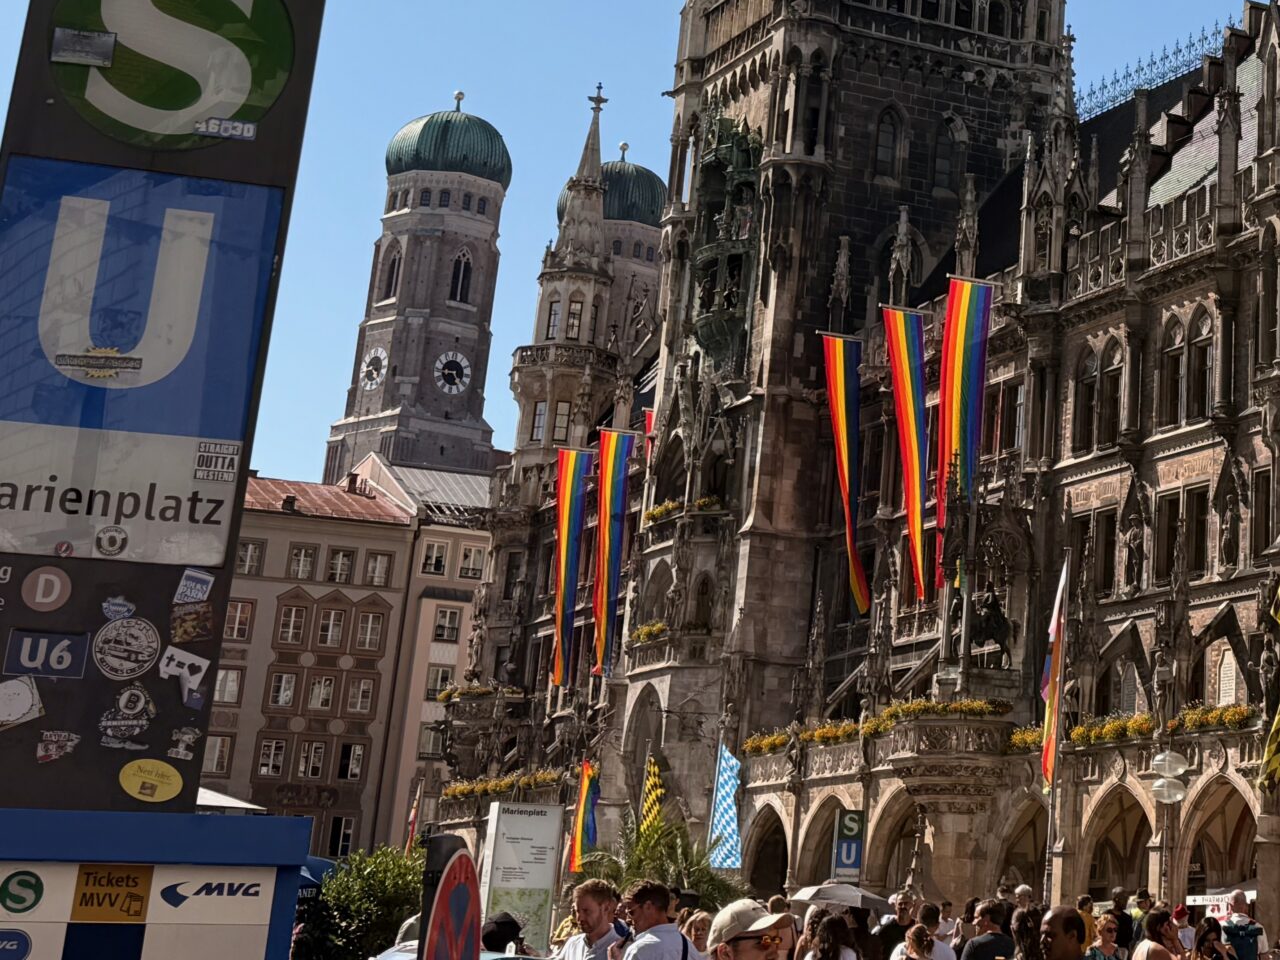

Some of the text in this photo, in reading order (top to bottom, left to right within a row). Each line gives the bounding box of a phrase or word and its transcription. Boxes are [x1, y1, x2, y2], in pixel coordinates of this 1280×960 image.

[38, 195, 215, 389] U
[200, 443, 238, 454] STRAIGHT
[197, 454, 235, 470] OUTTA
[196, 470, 234, 481] WESTEND
[0, 475, 225, 525] arienplatz
[34, 573, 61, 603] D
[19, 637, 72, 670] U6
[502, 807, 548, 817] Marienplatz
[843, 813, 859, 836] S
[841, 842, 857, 865] U
[84, 872, 139, 888] Tickets
[192, 882, 261, 897] MVG
[6, 875, 36, 910] S
[79, 892, 121, 908] MVV
